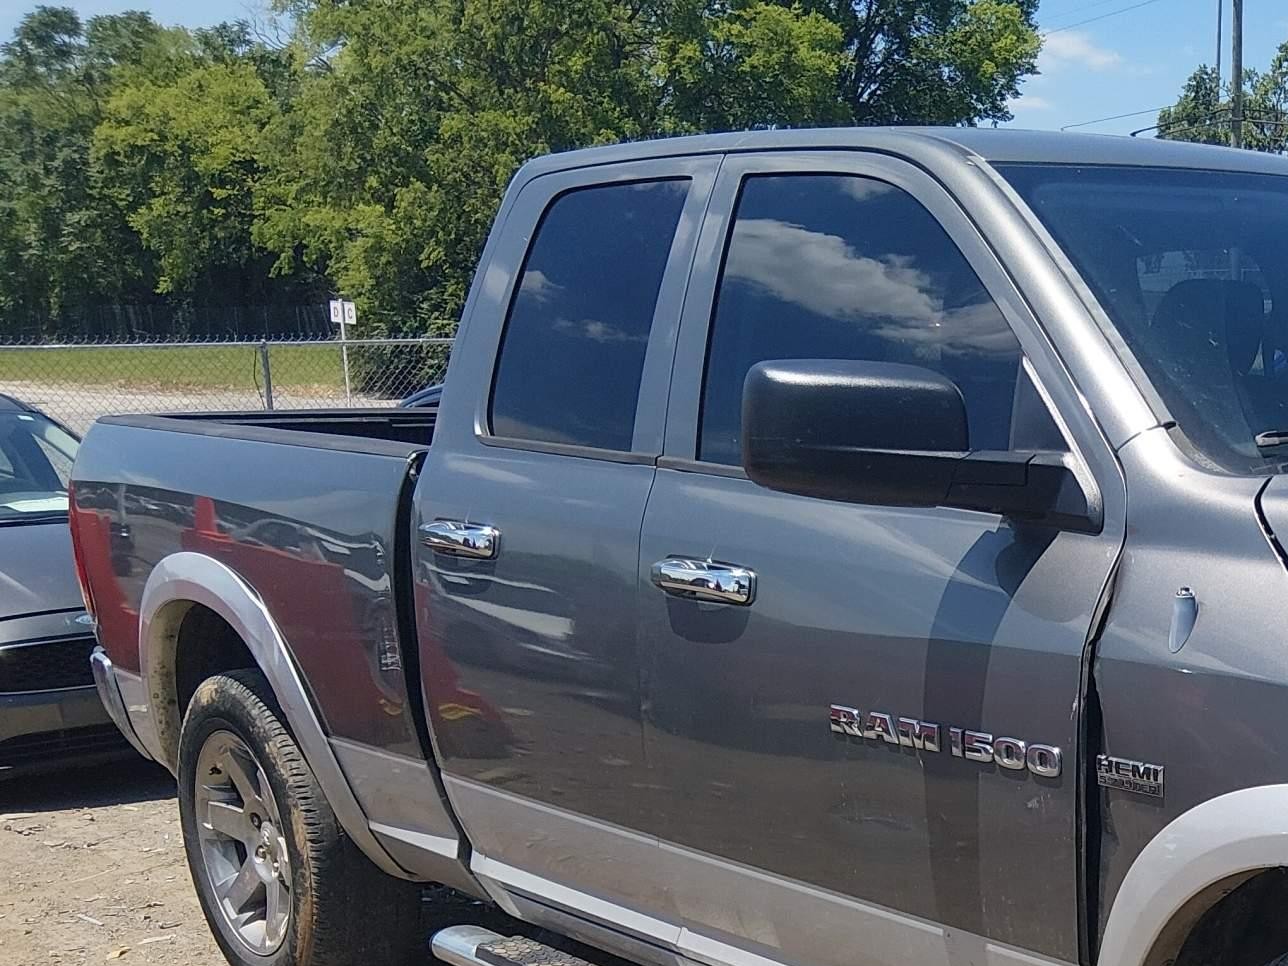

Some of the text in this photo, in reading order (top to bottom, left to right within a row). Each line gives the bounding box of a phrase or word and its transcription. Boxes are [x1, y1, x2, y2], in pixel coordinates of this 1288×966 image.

[829, 704, 1063, 778] RAM 1500
[1097, 756, 1162, 783] HEMI
